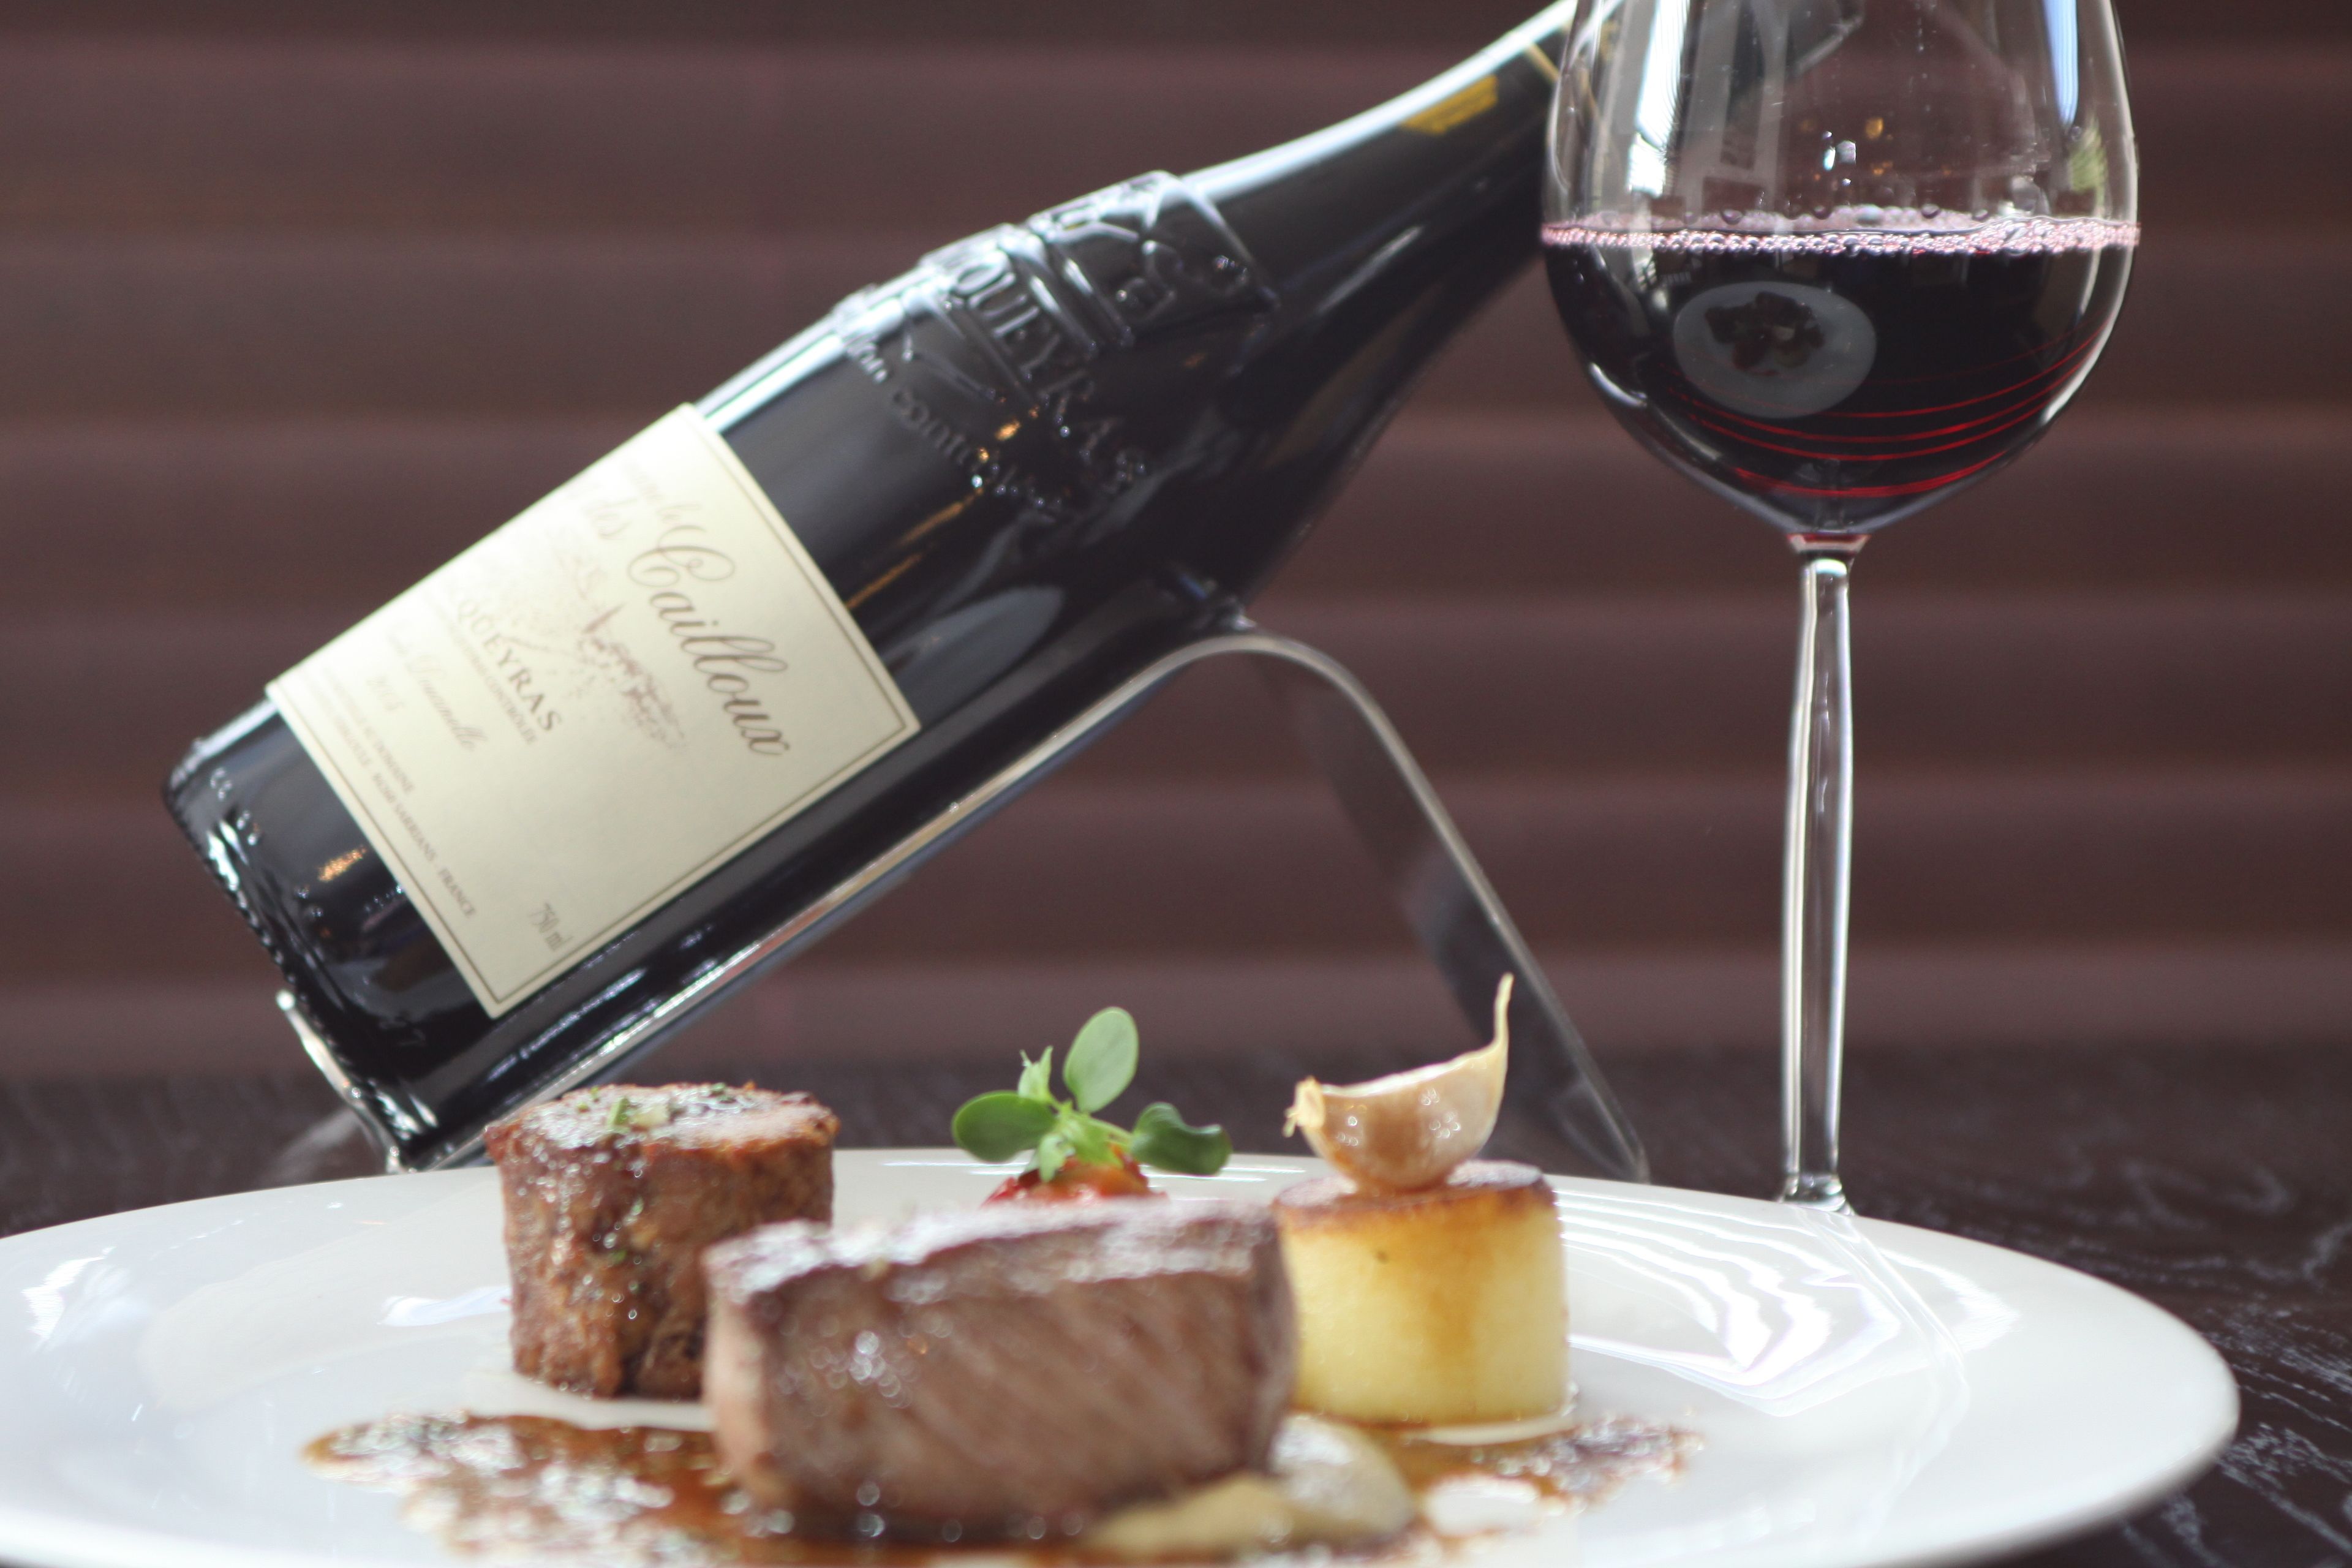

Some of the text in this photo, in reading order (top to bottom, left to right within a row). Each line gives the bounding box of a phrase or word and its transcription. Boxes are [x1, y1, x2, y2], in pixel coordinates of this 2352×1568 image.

[457, 600, 562, 731] QUEYRAS
[627, 526, 790, 755] Cailloux
[438, 869, 476, 917] FRANCE
[530, 902, 558, 932] 750
